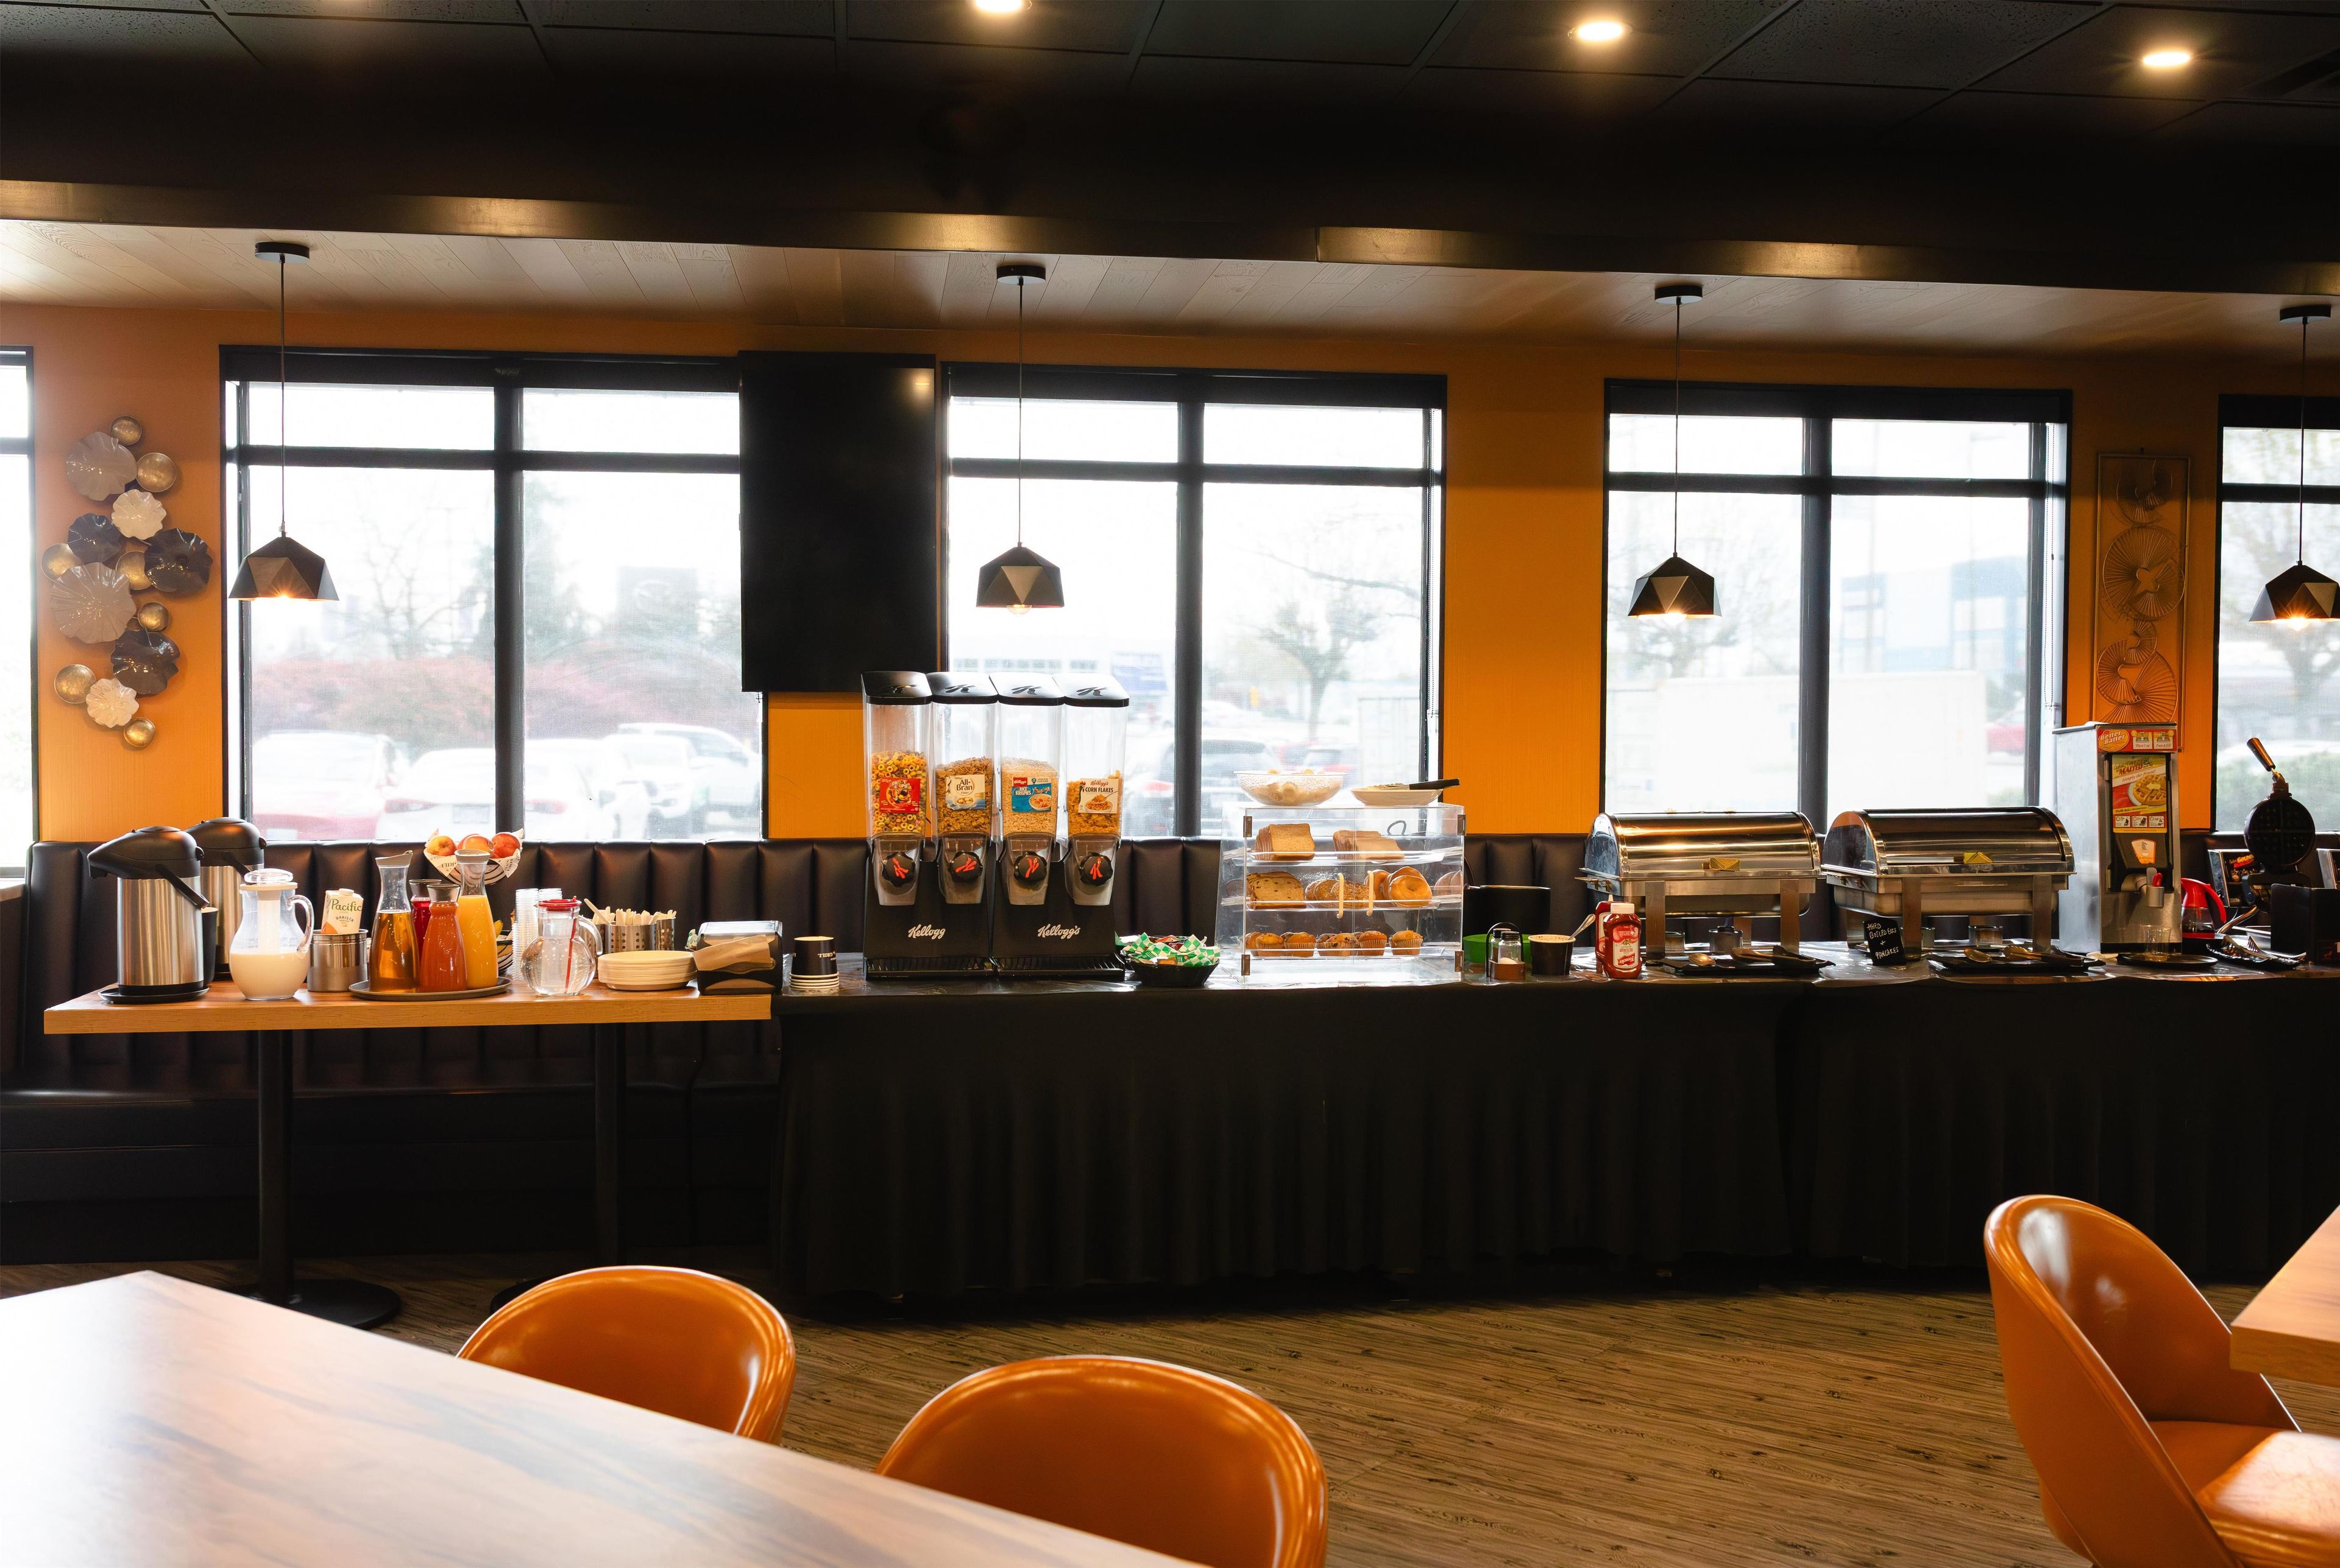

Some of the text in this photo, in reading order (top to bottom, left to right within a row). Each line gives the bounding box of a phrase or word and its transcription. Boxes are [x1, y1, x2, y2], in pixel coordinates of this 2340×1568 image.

[331, 898, 363, 912] Pacific
[907, 924, 946, 940] Kellogg
[1037, 924, 1081, 940] Kellogg's
[1867, 922, 1882, 931] HARD
[1869, 929, 1887, 939] BOILED
[1875, 946, 1899, 960] PANCAKES
